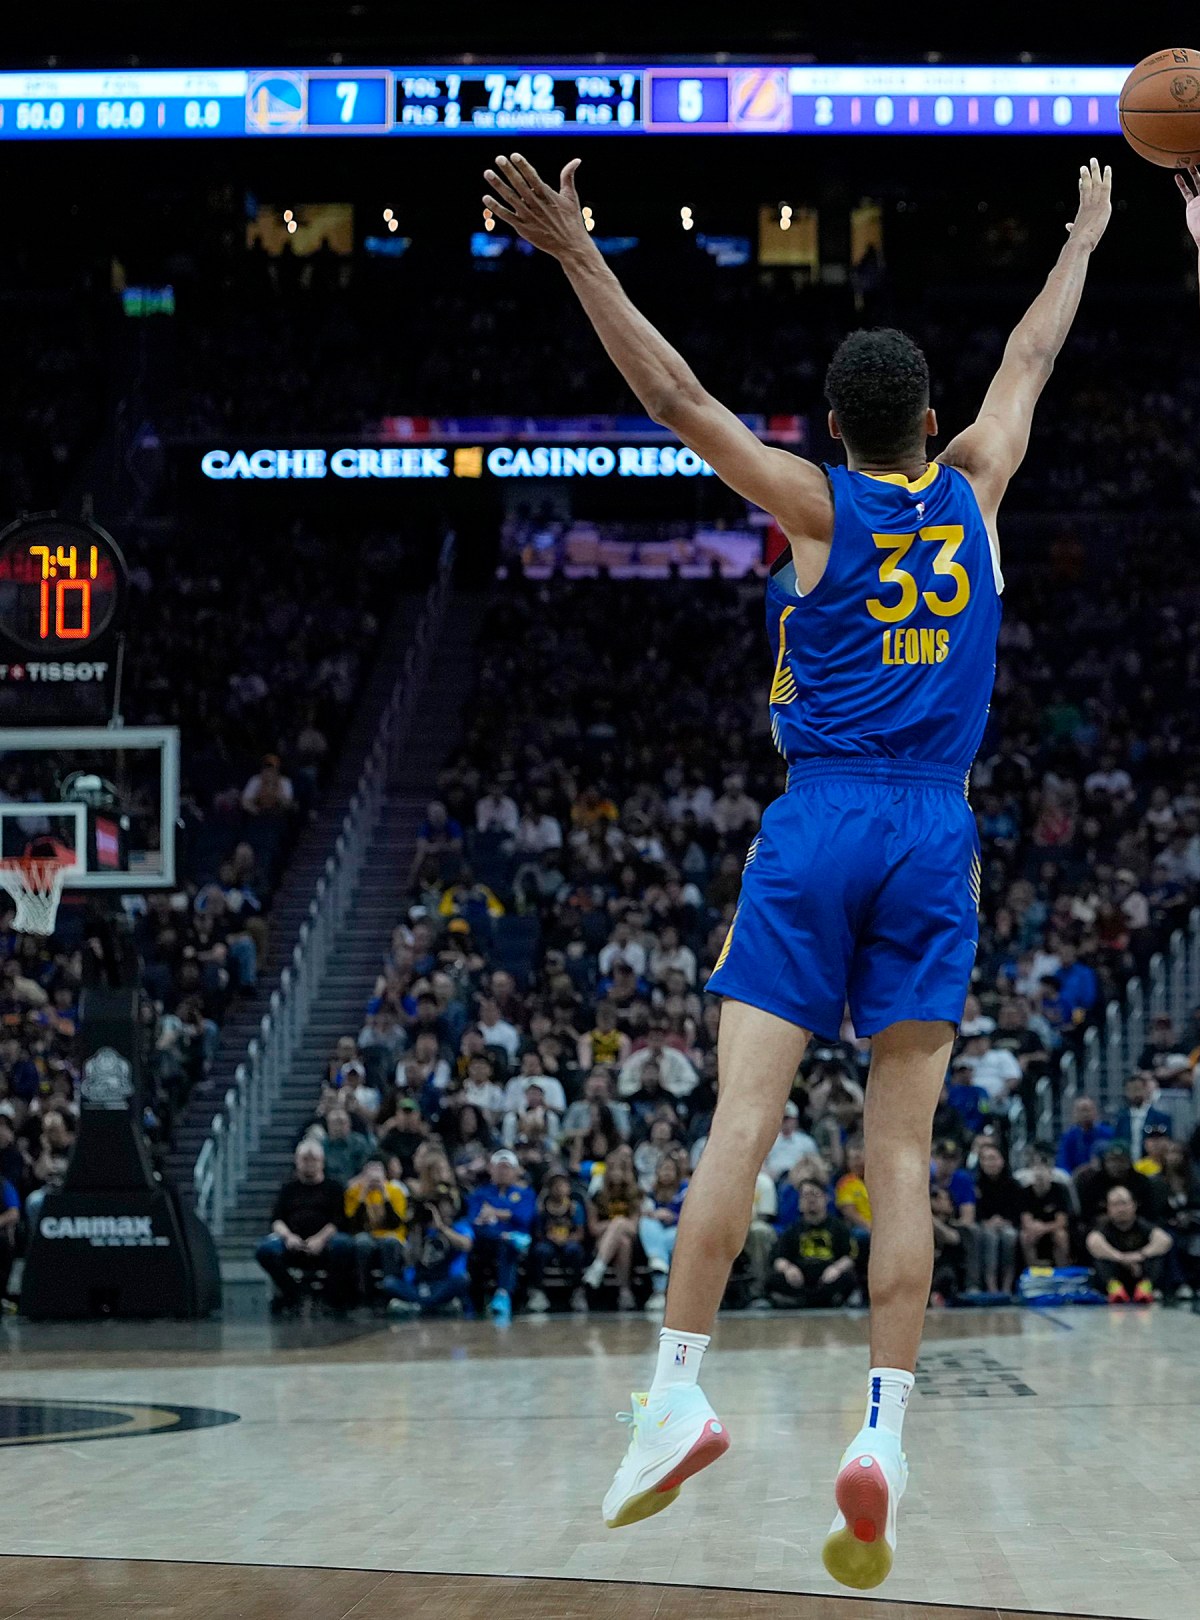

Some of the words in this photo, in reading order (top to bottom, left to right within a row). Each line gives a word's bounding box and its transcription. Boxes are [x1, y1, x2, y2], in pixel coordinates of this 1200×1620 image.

[336, 81, 359, 123] 7
[446, 74, 461, 99] 7
[485, 74, 554, 112] 7:42
[619, 73, 635, 99] 7
[678, 79, 703, 122] 5
[185, 100, 220, 128] 0.0
[874, 96, 894, 126] 0
[934, 96, 954, 126] 0
[994, 96, 1013, 126] 0
[1053, 96, 1073, 126] 0
[201, 449, 326, 478] CACHE
[330, 447, 449, 478] CREEK
[487, 447, 615, 477] CASINO
[29, 545, 98, 580] 7:41
[866, 525, 970, 623] 33
[39, 579, 91, 639] 10
[882, 628, 950, 665] LEONS
[25, 662, 108, 682] TISSOT
